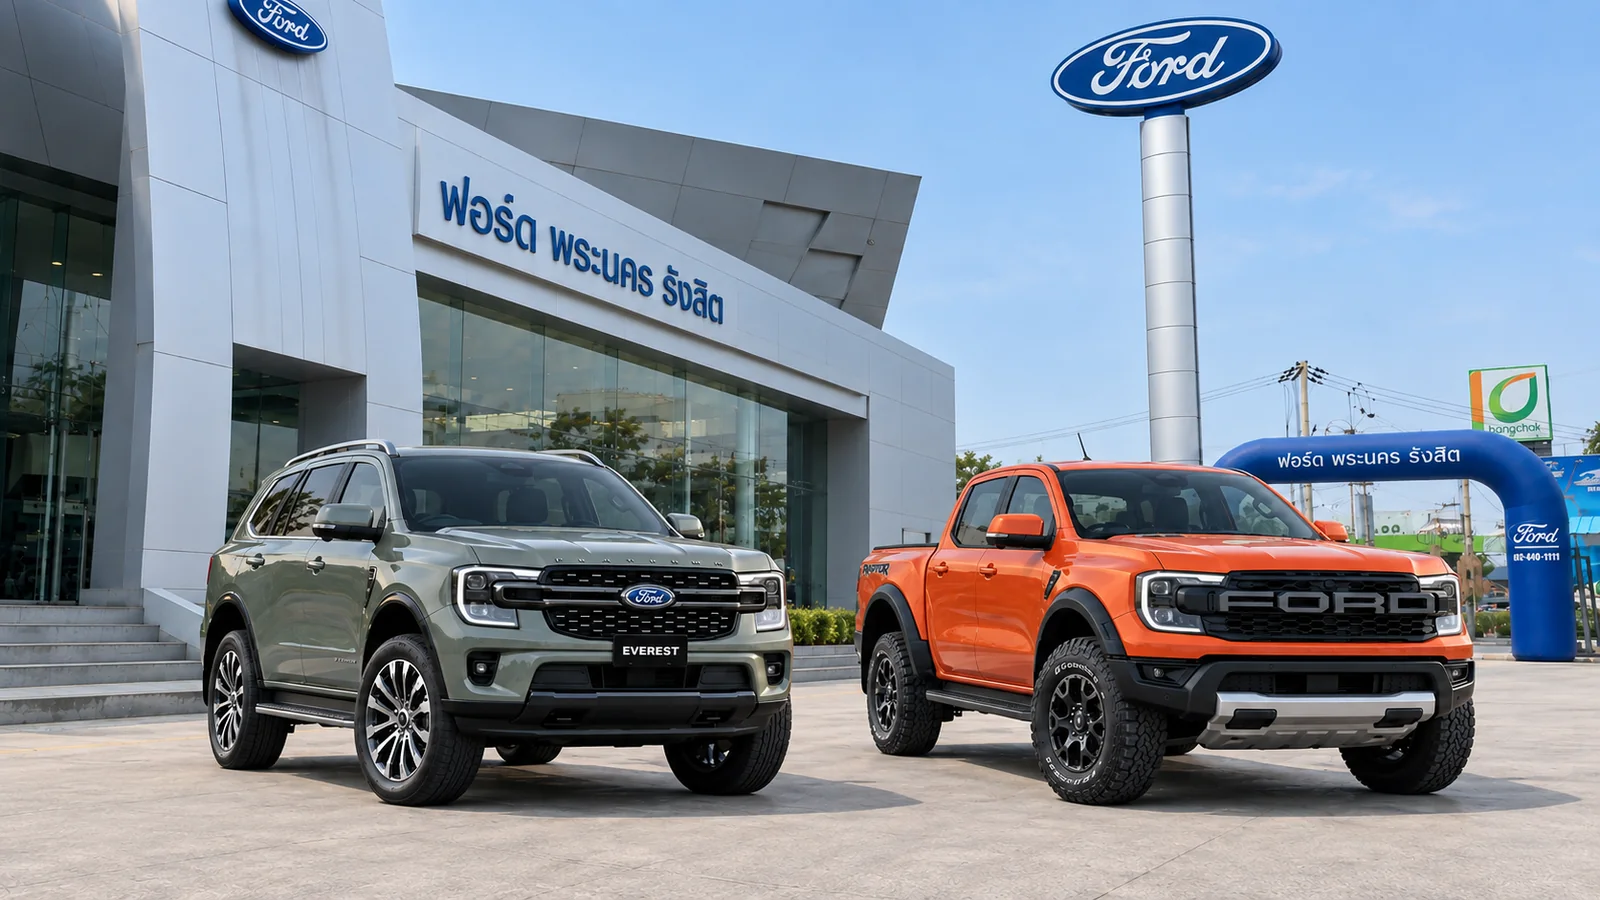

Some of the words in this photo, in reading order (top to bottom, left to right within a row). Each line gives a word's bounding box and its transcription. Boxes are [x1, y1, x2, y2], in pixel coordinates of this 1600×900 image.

[257, 0, 309, 41] Ford
[1090, 30, 1229, 96] Ford
[440, 175, 537, 254] ฟอร์ด
[550, 225, 654, 297] พระนคร
[662, 264, 724, 325] รังสิต
[1488, 422, 1541, 437] bangchak
[1277, 450, 1324, 468] ฟอร์ด
[1331, 450, 1400, 466] พระนคร
[1513, 523, 1560, 543] Ford
[635, 589, 665, 604] Ford
[1219, 590, 1436, 614] FORD
[622, 646, 680, 656] EVEREST
